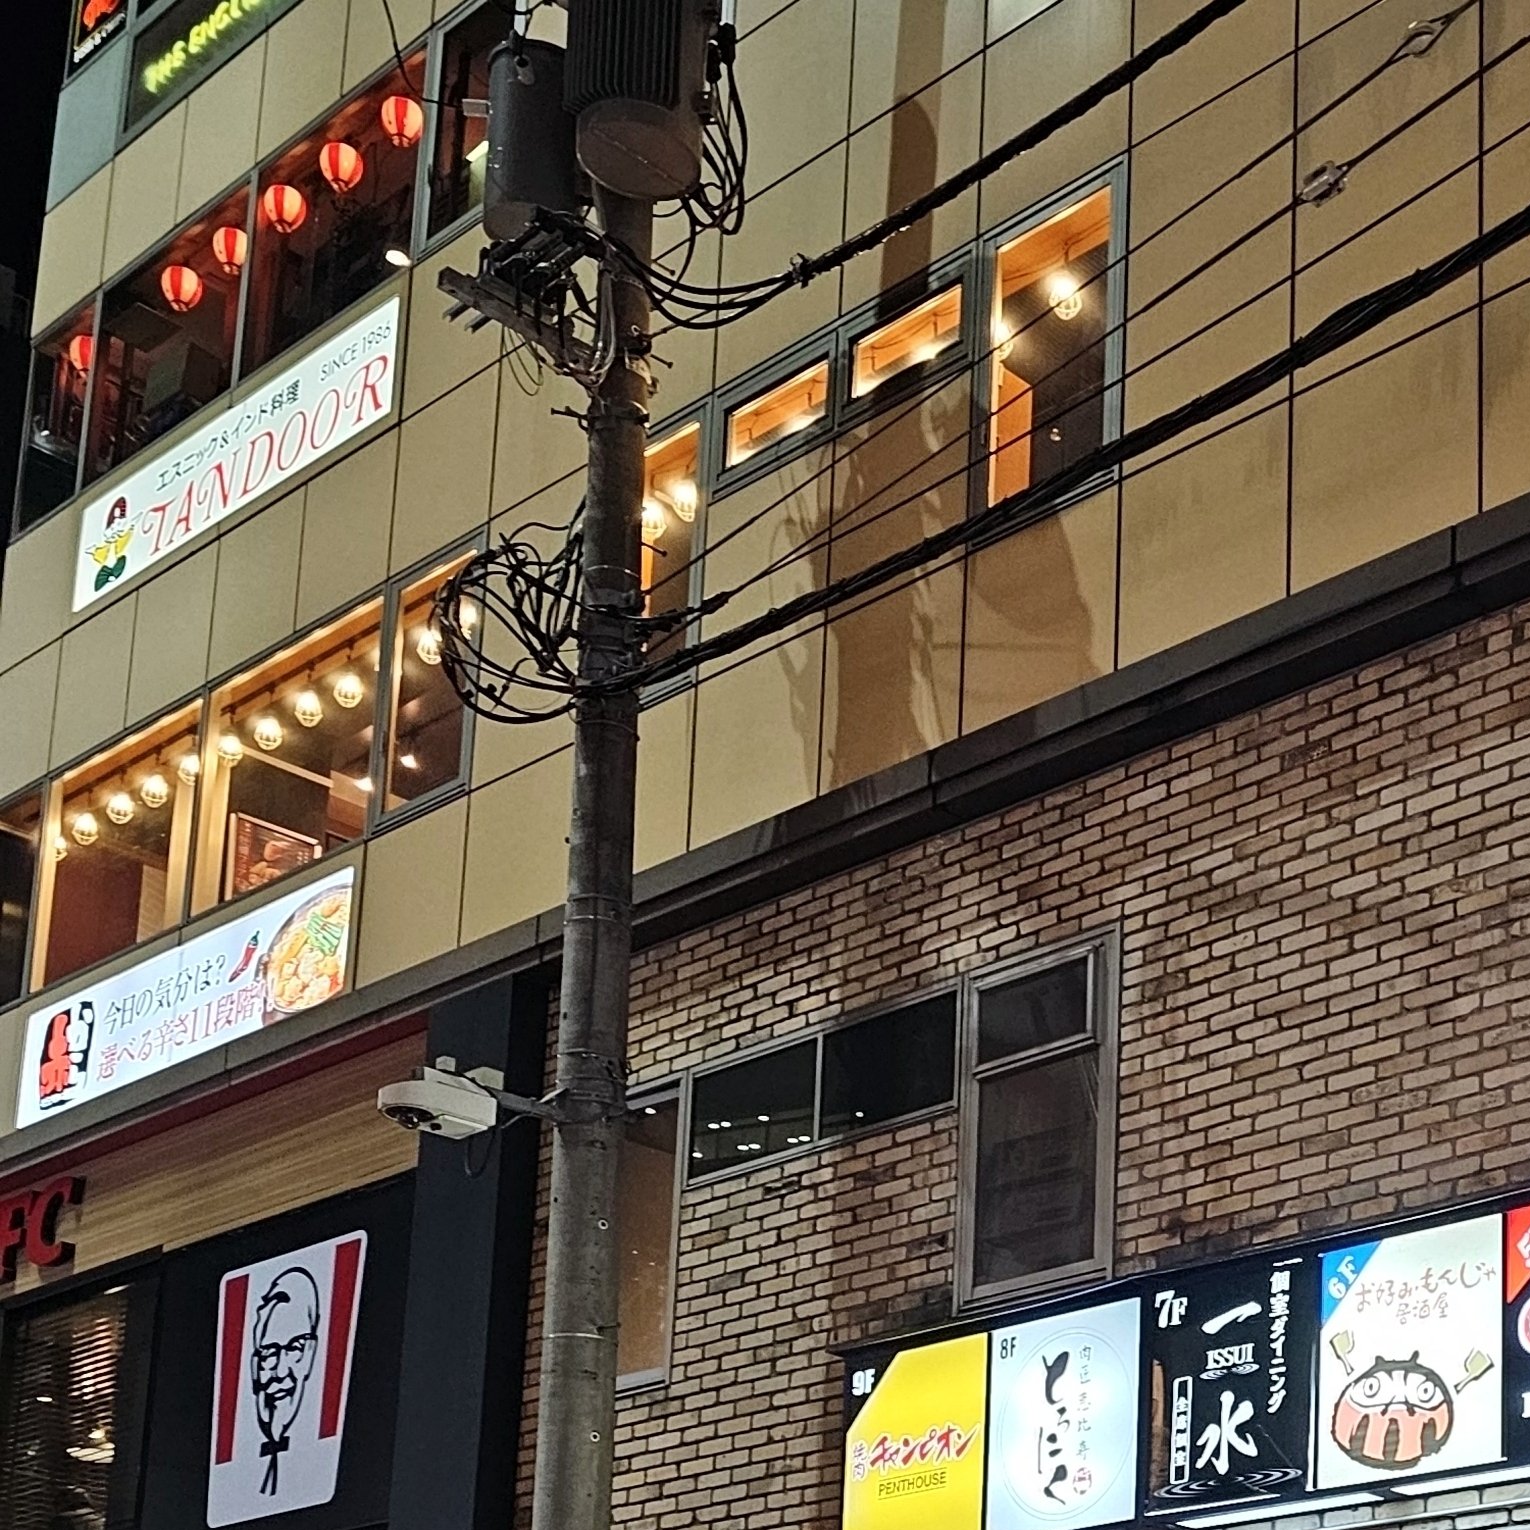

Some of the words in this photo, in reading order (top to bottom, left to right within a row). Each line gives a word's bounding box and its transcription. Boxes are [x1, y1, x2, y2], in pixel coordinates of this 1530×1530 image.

[319, 342, 358, 382] SINCE
[361, 320, 392, 355] 1986
[141, 355, 389, 556] TANDOOR
[103, 954, 226, 1035] 今日の気分は?
[1327, 1256, 1359, 1301] 6F
[1154, 1290, 1188, 1329] 7F
[999, 1336, 1018, 1360] 8F
[1205, 1343, 1255, 1371] ISSUI
[851, 1368, 876, 1397] 9F
[868, 1424, 979, 1470] チャンピオン
[878, 1471, 947, 1497] PENTHOUSE
